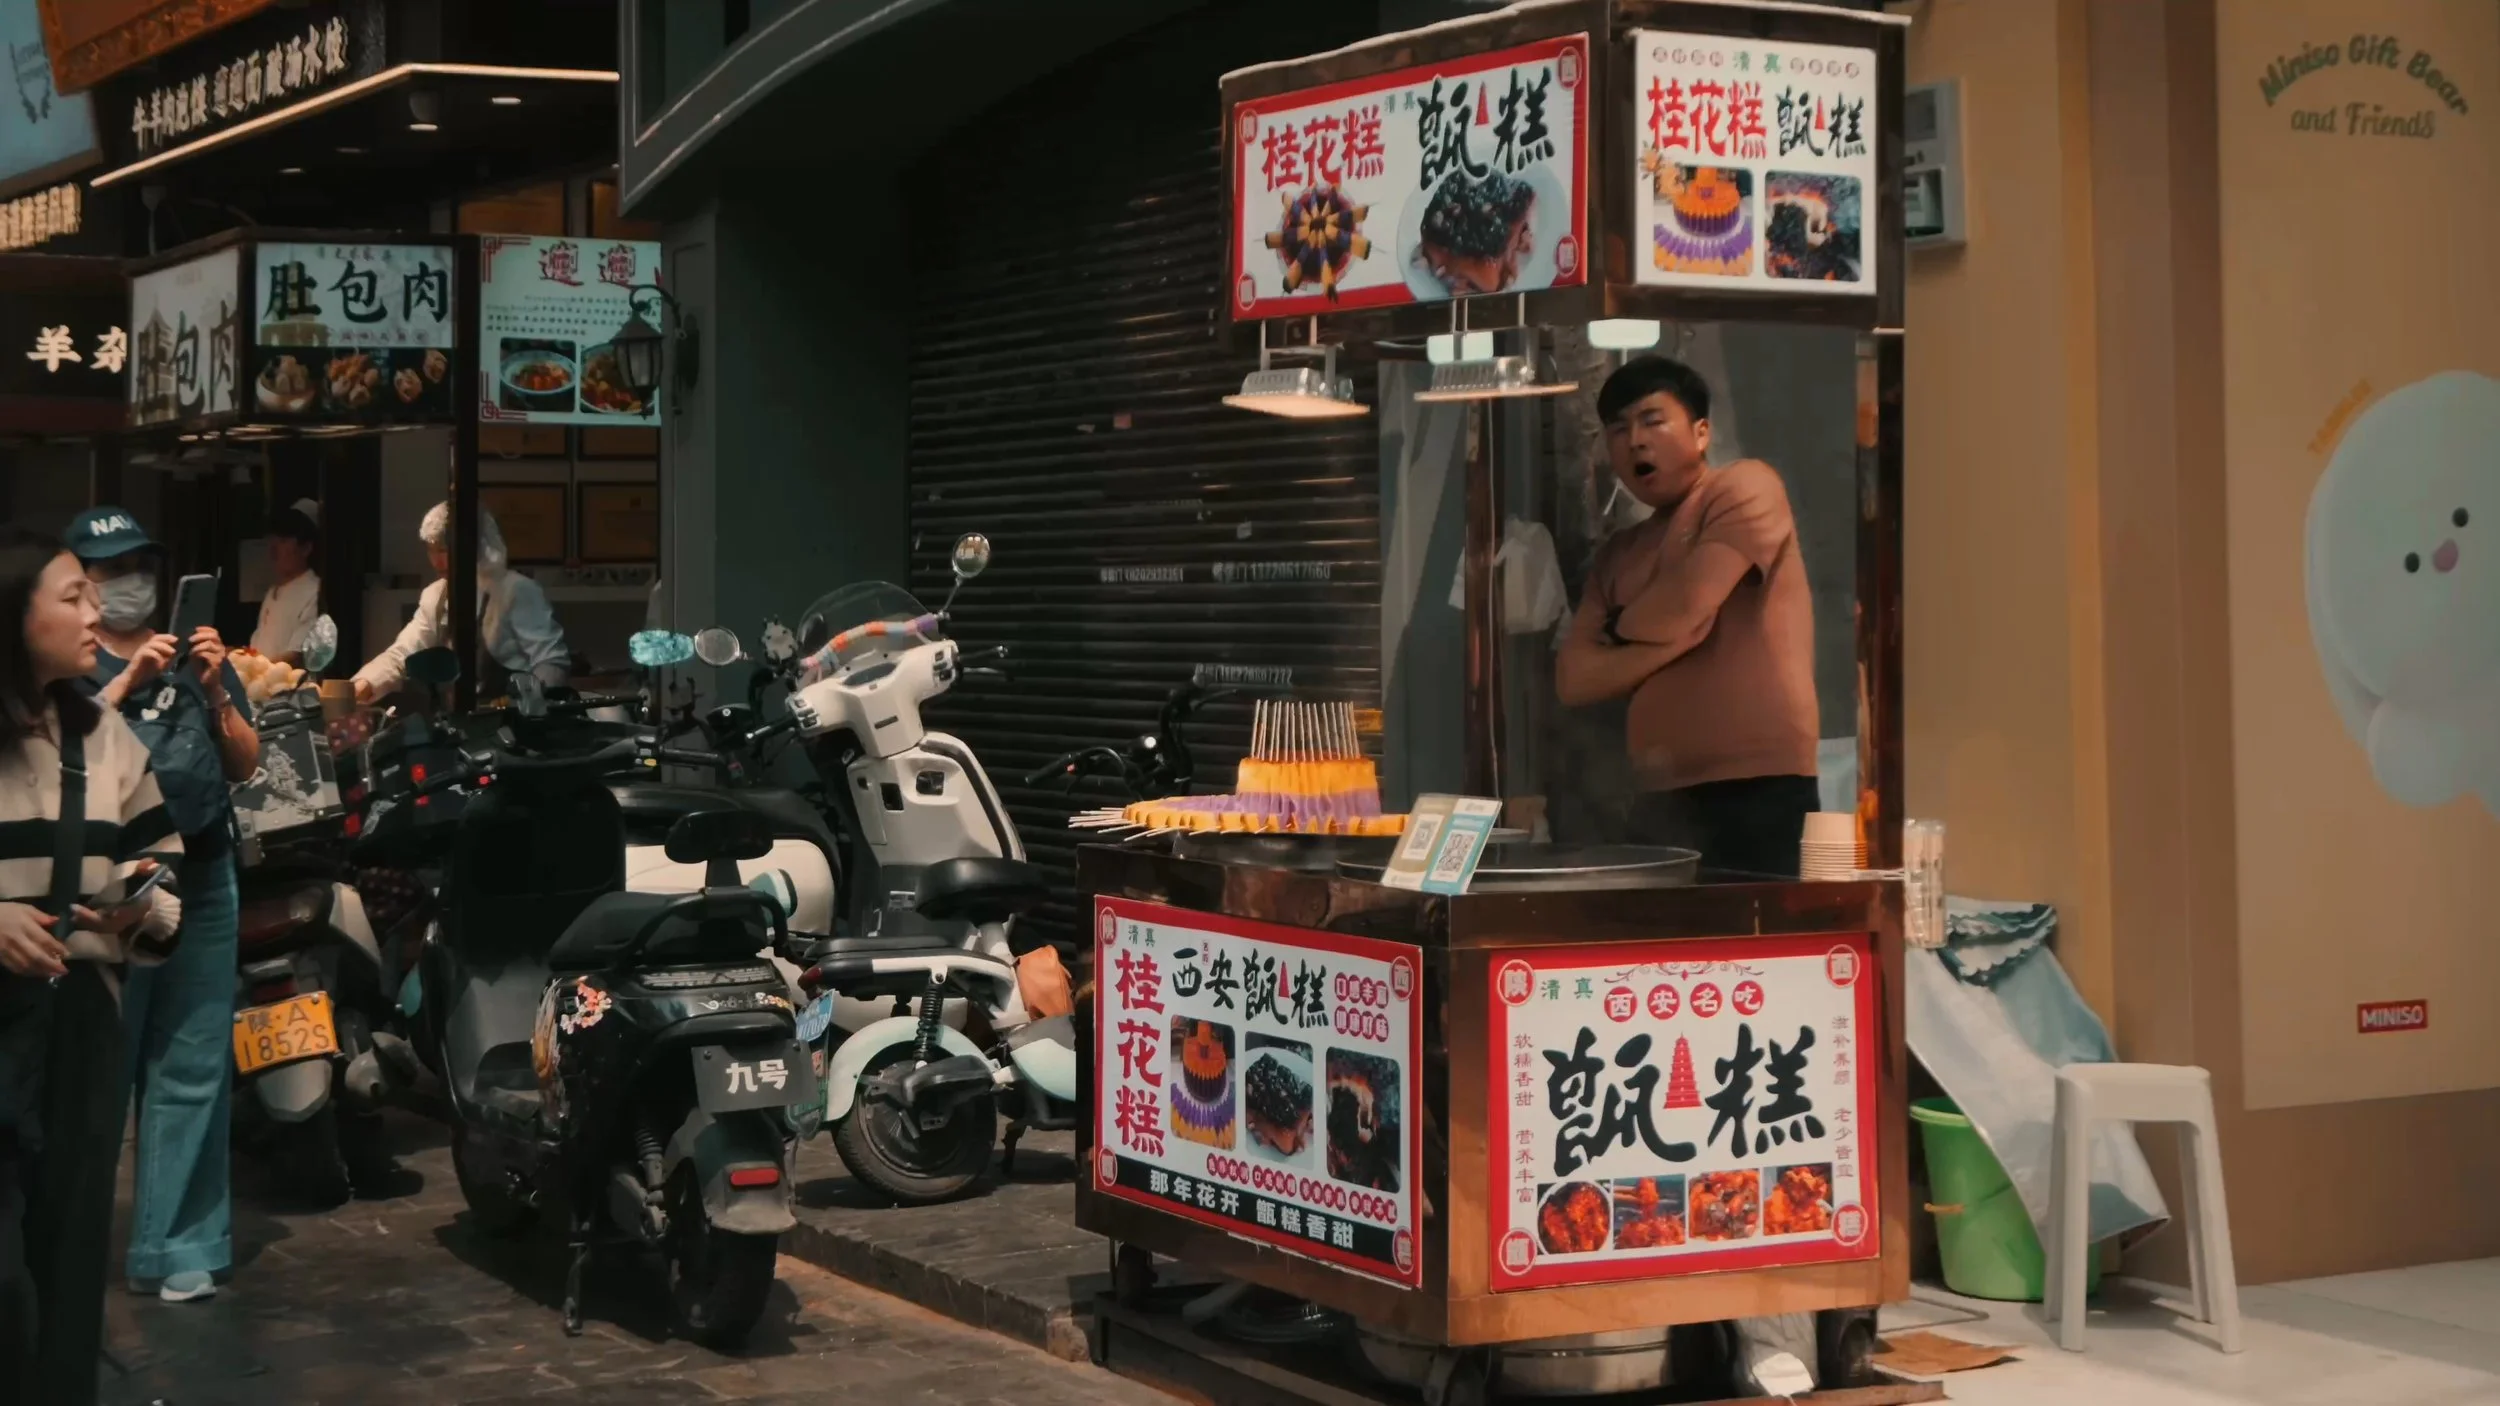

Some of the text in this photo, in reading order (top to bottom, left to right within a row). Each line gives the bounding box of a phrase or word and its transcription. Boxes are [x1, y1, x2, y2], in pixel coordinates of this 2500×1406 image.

[1733, 50, 1781, 74] 清真
[2258, 34, 2468, 116] Miniso Gift Bear
[1647, 75, 1767, 159] 桂花糕
[2291, 102, 2436, 139] and Friends
[1261, 103, 1386, 192] 桂花糕
[263, 259, 449, 324] 肚包肉
[1127, 924, 1157, 947] 清真
[1540, 977, 1594, 1000] 清真
[1606, 983, 1763, 1020] 西安名吃
[2362, 1005, 2424, 1027] MINISO
[726, 1059, 788, 1093] 九号
[1114, 948, 1166, 1158] 桂花糕
[1513, 1033, 1536, 1203] 软糯香甜 营养丰富
[1834, 1107, 1854, 1178] 老少皆宜
[1150, 1170, 1240, 1216] 那年花开
